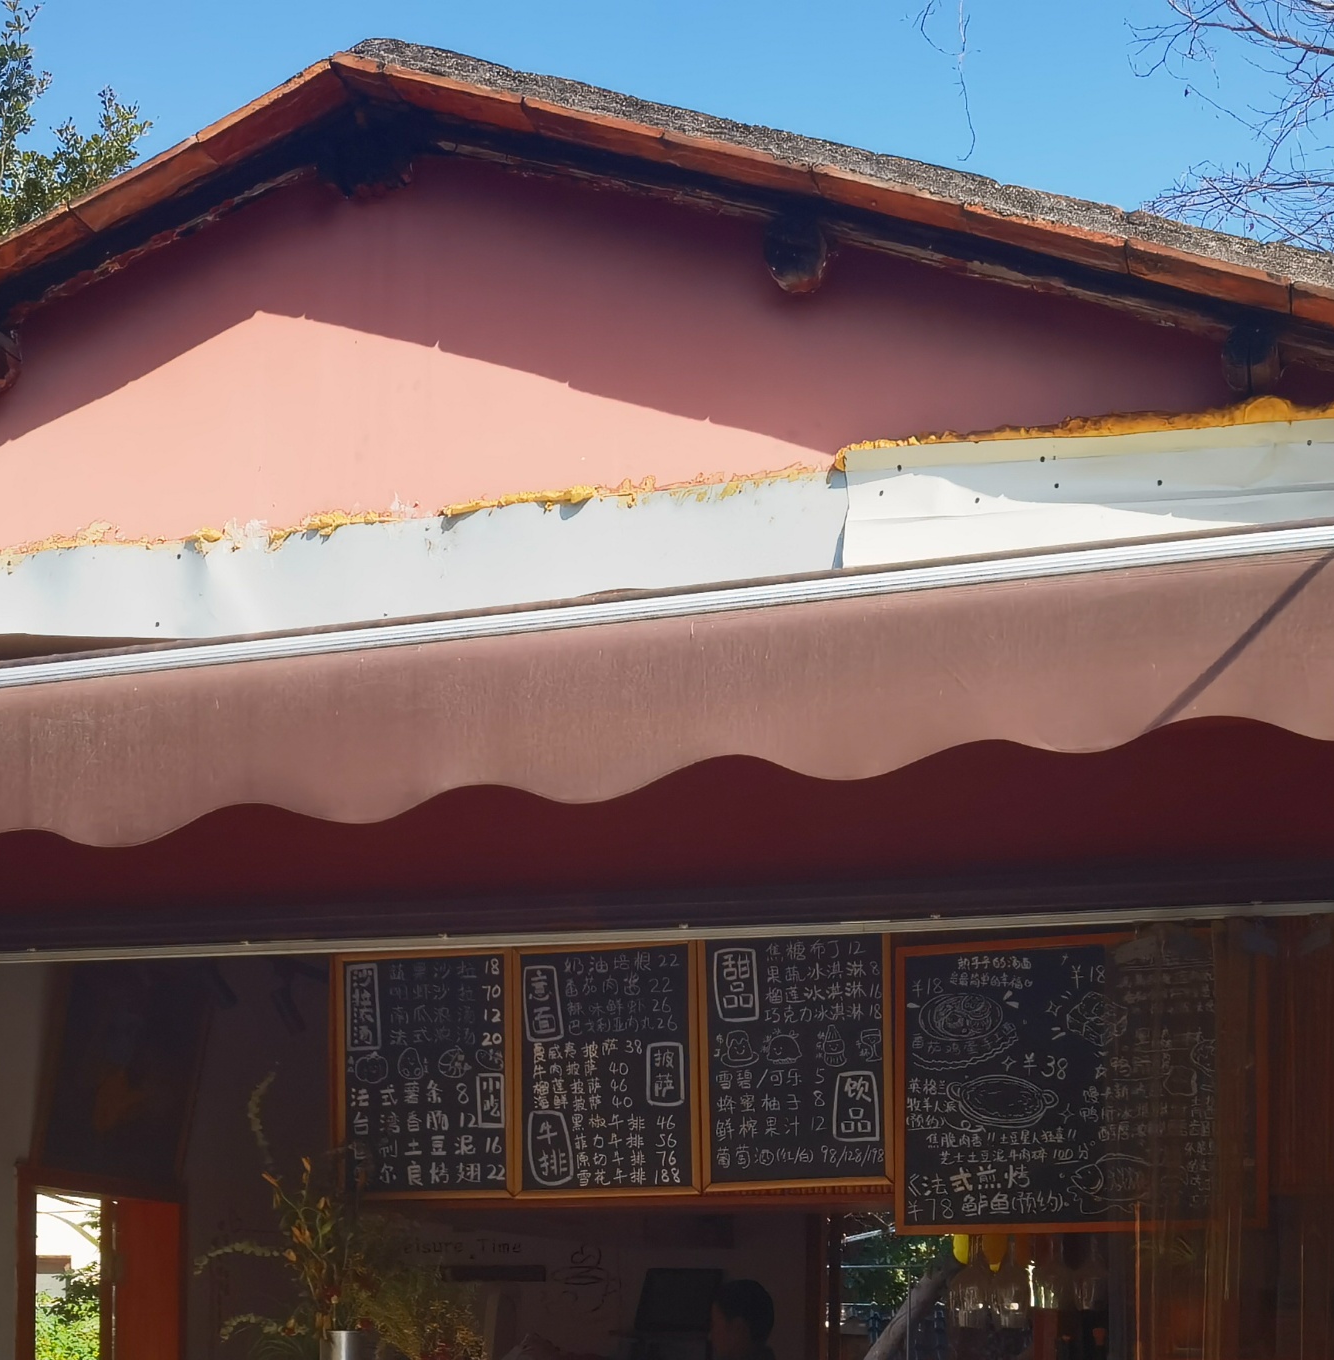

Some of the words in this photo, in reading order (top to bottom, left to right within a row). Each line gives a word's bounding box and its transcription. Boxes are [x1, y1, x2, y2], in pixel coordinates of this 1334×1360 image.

[765, 939, 840, 962] 焦糖布丁
[848, 941, 866, 956] 12
[484, 957, 501, 976] 18
[563, 951, 652, 975] 奶油培根
[658, 953, 680, 967] 22
[766, 960, 867, 984] 果蔬冰淇淋
[869, 960, 880, 976] 8
[565, 972, 641, 997] 番茄肉酱
[649, 976, 673, 993] 22
[722, 953, 754, 1009] 甜品
[869, 983, 882, 1000] 16
[529, 969, 557, 1034] 意面
[652, 997, 672, 1013] 26
[483, 1008, 502, 1024] 12
[657, 1014, 678, 1031] 26
[764, 1003, 865, 1024] 巧克力冰淇淋
[869, 1003, 883, 1020] 18
[481, 1032, 503, 1047] 20
[624, 1039, 643, 1054] 38
[608, 1061, 629, 1076] 40
[653, 1050, 675, 1098] 披萨
[610, 1078, 628, 1092] 46
[715, 1069, 802, 1090] 雪碧/可乐
[814, 1068, 825, 1084] 5
[908, 1077, 947, 1095] 英格兰
[350, 1079, 443, 1107] 法式薯条
[455, 1082, 469, 1105] 8
[482, 1079, 501, 1117] 小吃
[612, 1095, 633, 1108] 40
[717, 1093, 802, 1115] 蜂蜜柚子
[813, 1090, 825, 1107] 8
[840, 1077, 872, 1133] 饮品
[459, 1111, 478, 1128] 12
[571, 1113, 646, 1132] 黑椒牛排
[656, 1114, 676, 1130] 46
[716, 1115, 800, 1142] 鲜榨果汁
[811, 1116, 827, 1131] 12
[485, 1136, 502, 1154] 16
[536, 1120, 568, 1176] 牛排
[574, 1133, 645, 1150] 菲力牛排
[655, 1133, 677, 1148] 56
[576, 1150, 647, 1169] 原切牛排
[655, 1151, 677, 1166] 76
[354, 1160, 481, 1187] 尔良烤翅
[486, 1163, 506, 1181] 22
[577, 1167, 647, 1187] 雪花牛排
[654, 1168, 681, 1185] 188
[404, 1237, 464, 1254] eisure
[477, 1238, 523, 1254] Time
